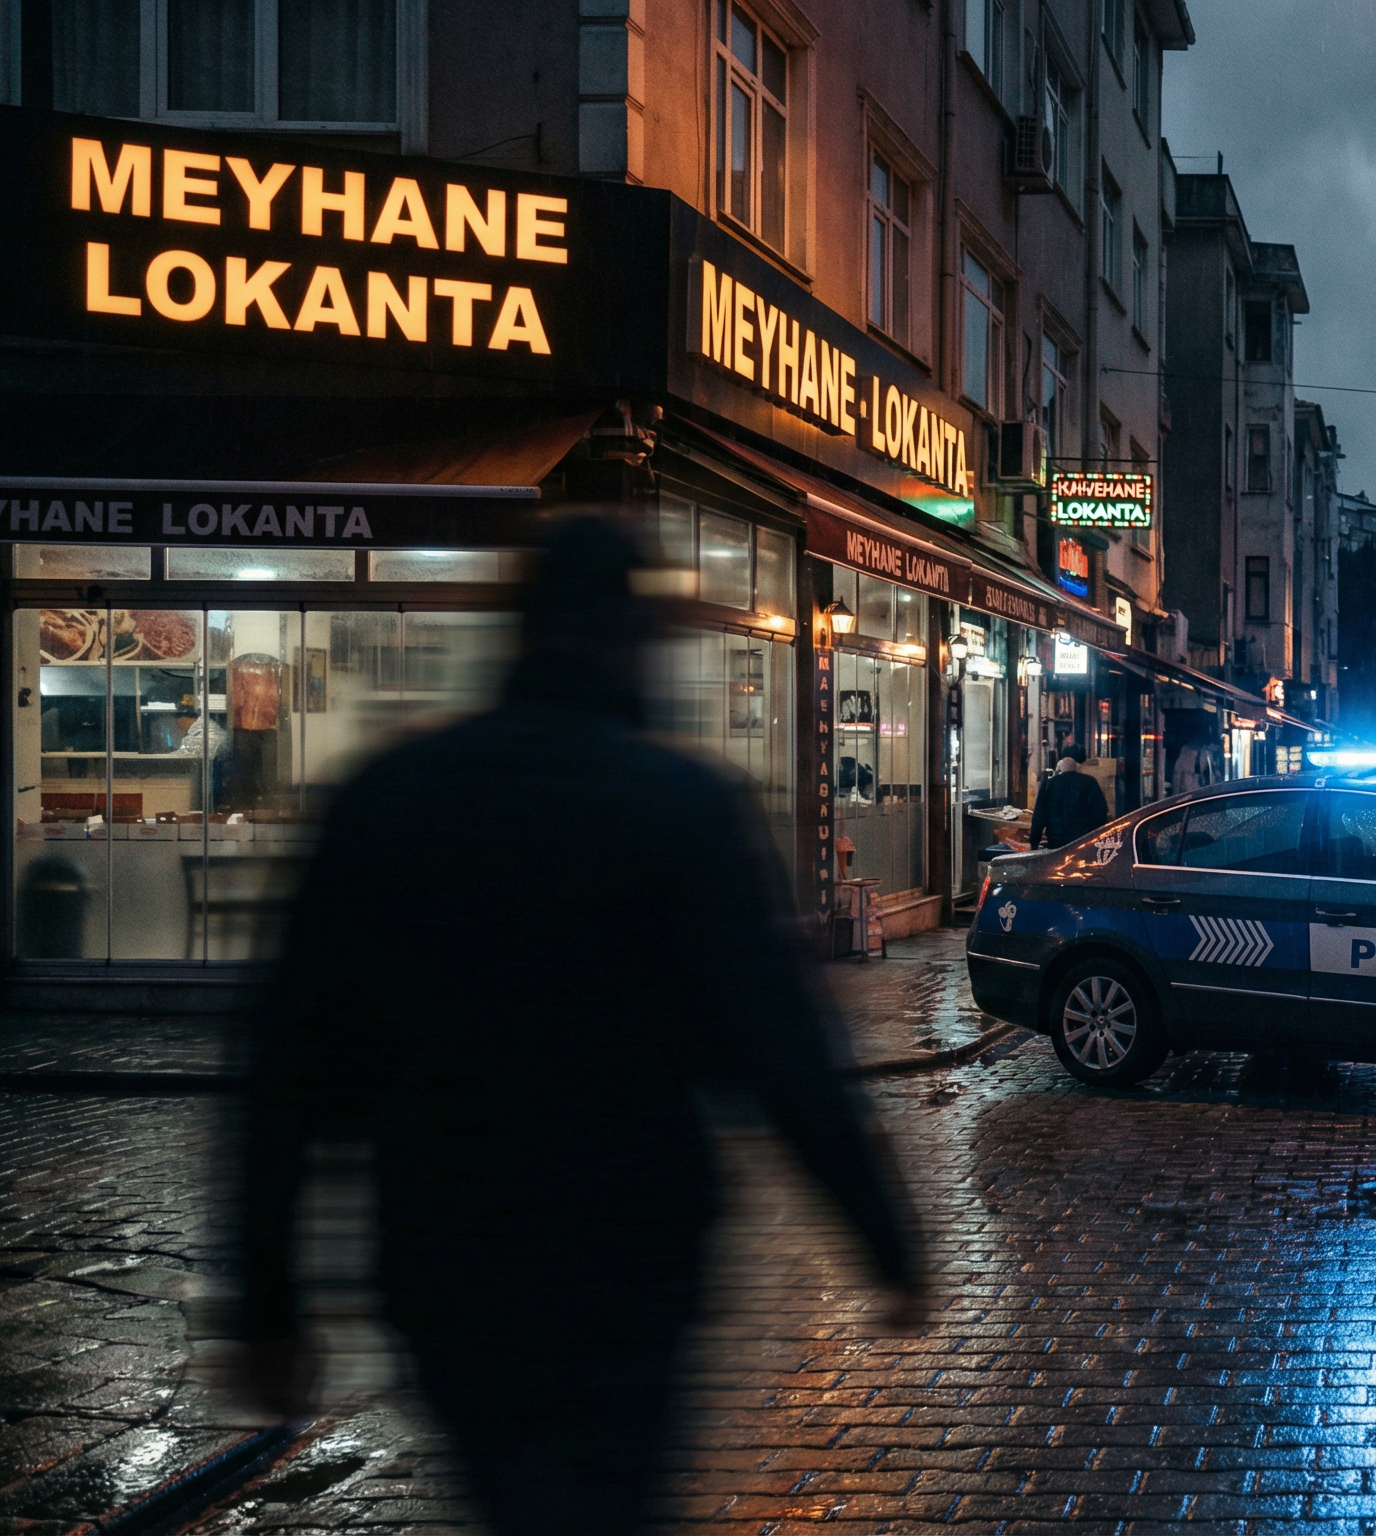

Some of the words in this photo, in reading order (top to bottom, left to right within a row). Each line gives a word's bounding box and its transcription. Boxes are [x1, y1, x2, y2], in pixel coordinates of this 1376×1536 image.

[71, 137, 568, 264] MEYHANE
[86, 242, 551, 355] LOKANTA
[702, 259, 856, 437] MEYHANE
[872, 376, 968, 497] LOKANTA
[0, 500, 133, 534] HANE
[162, 503, 373, 538] LOKANTA
[1057, 502, 1145, 520] LOKANTA
[847, 530, 902, 577] MEYHANE
